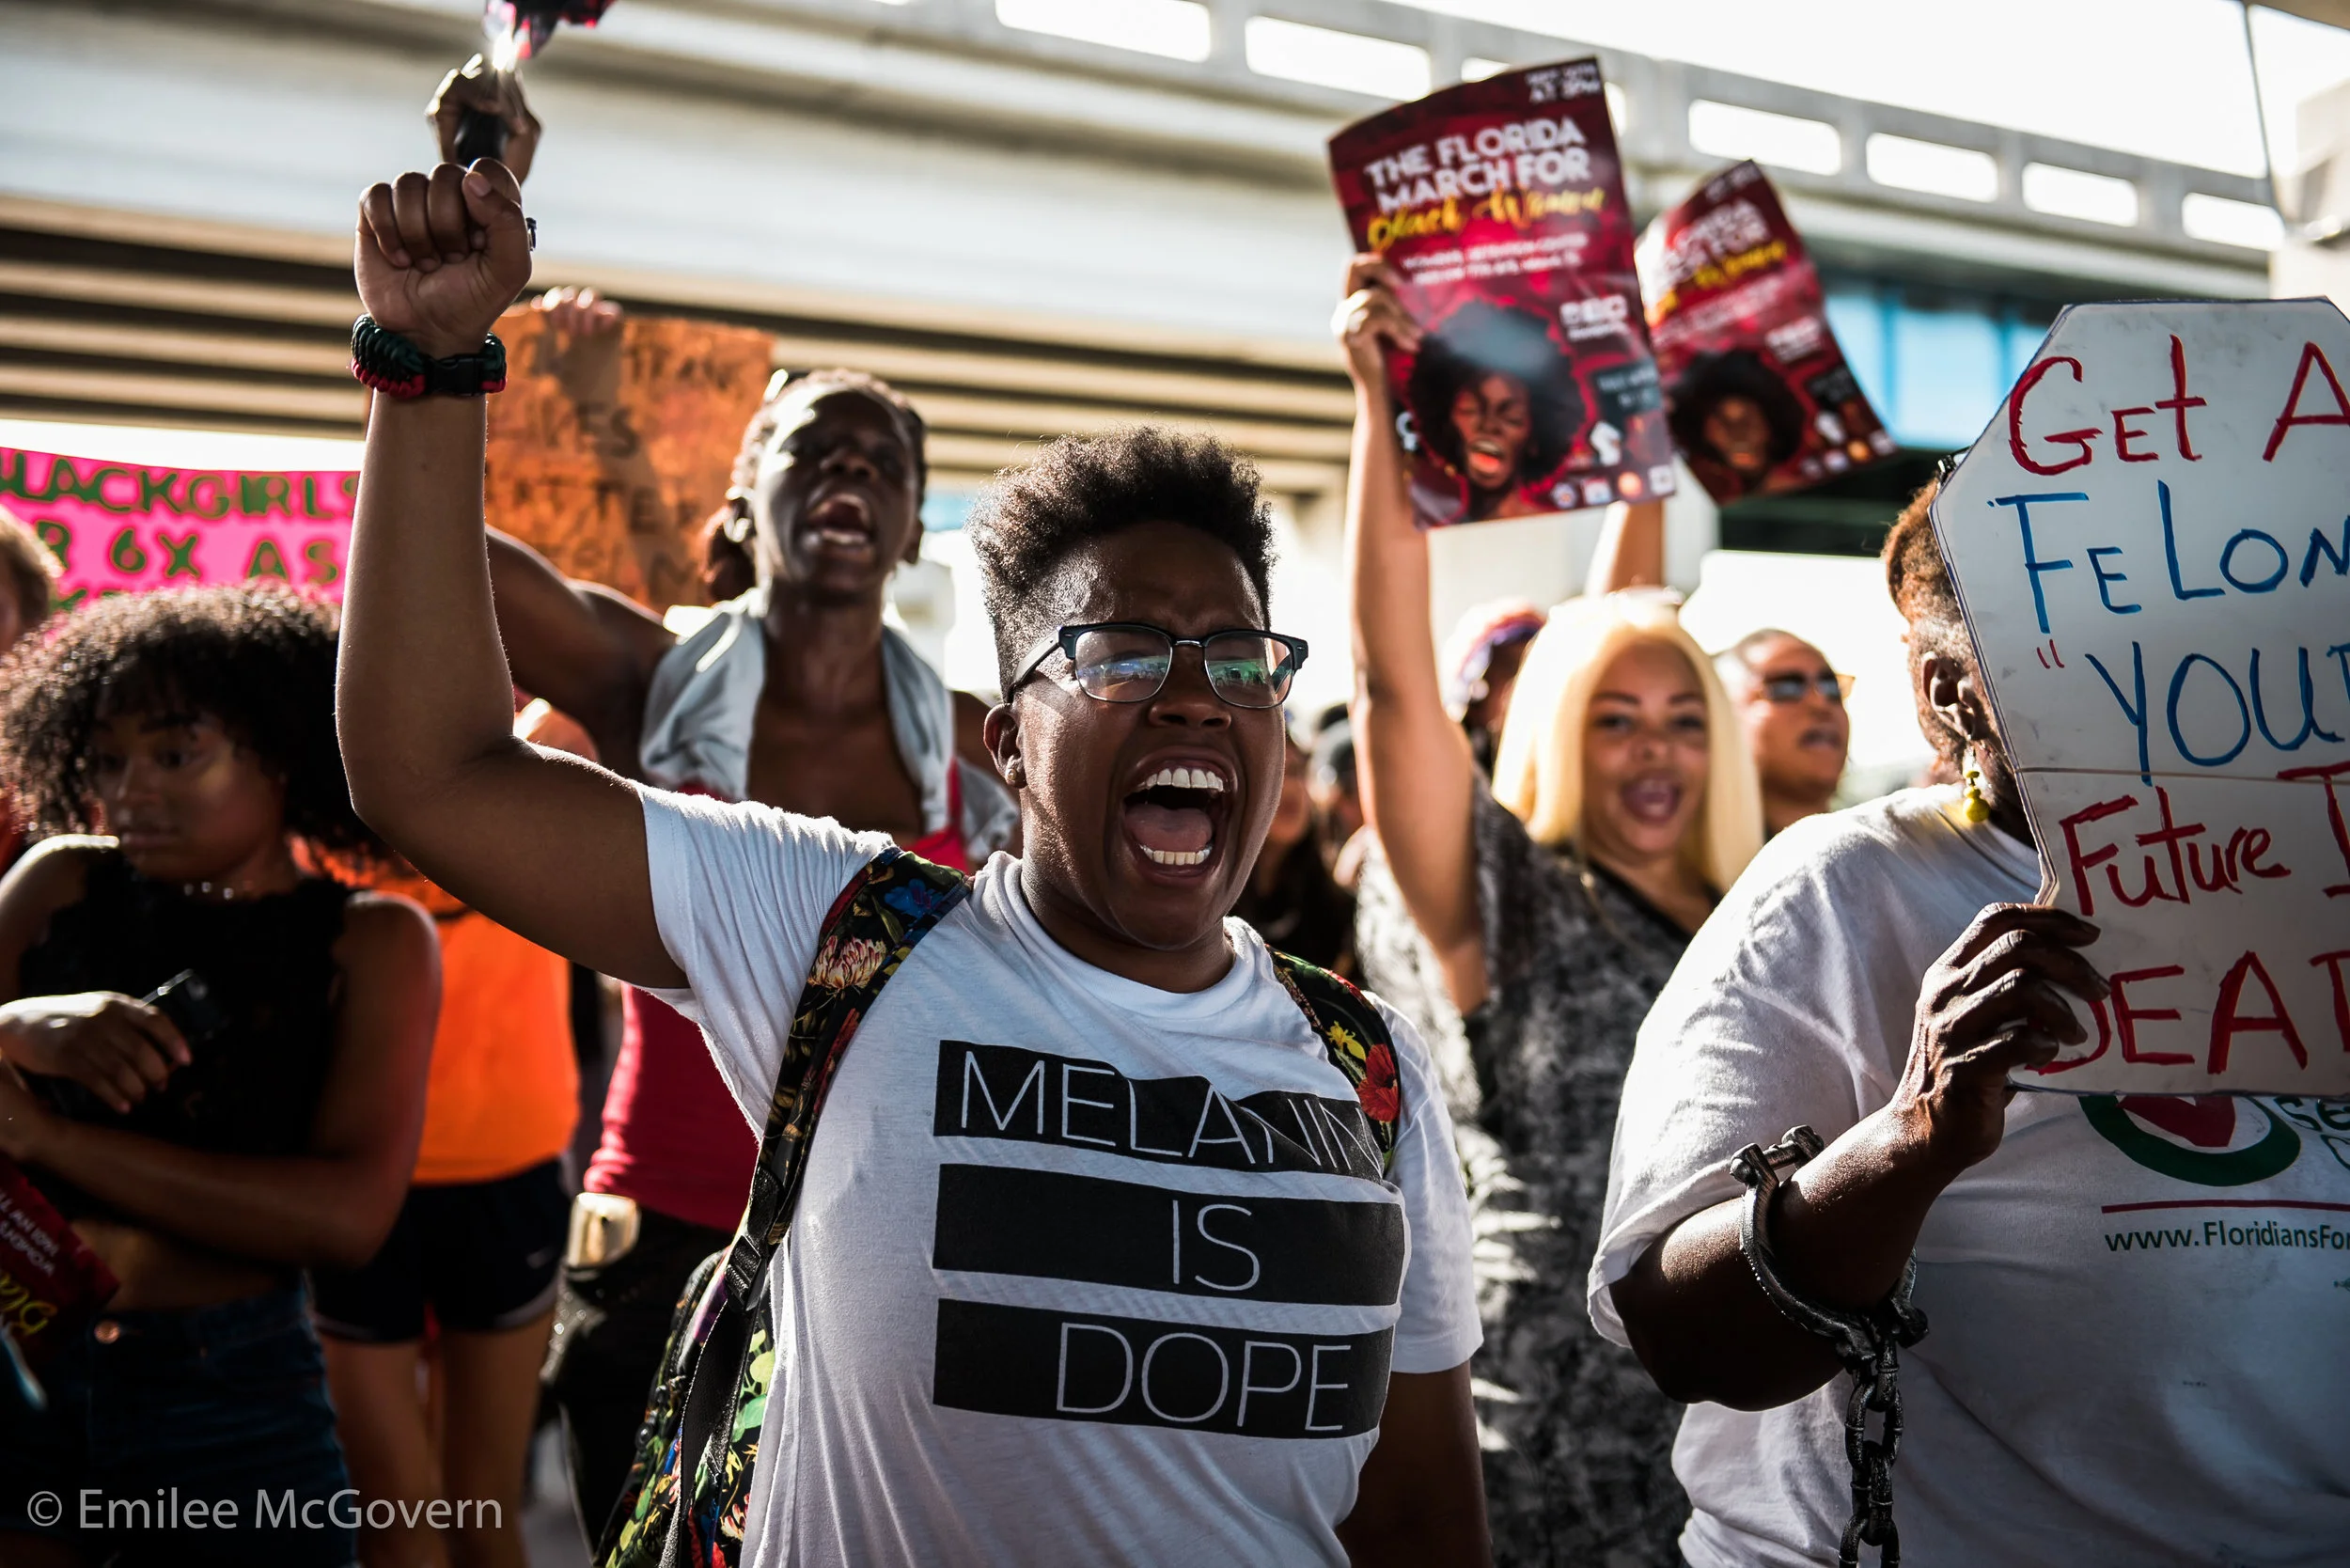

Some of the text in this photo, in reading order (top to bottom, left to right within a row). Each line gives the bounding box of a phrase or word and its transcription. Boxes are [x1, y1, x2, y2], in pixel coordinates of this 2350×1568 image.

[1364, 116, 1587, 187] THE FLORIDA
[1377, 146, 1590, 213] MARCH FOR
[2262, 340, 2350, 463] A
[961, 1050, 1383, 1179] MELANIN
[1171, 1199, 1261, 1293] IS
[1056, 1322, 1352, 1431] DOPE
